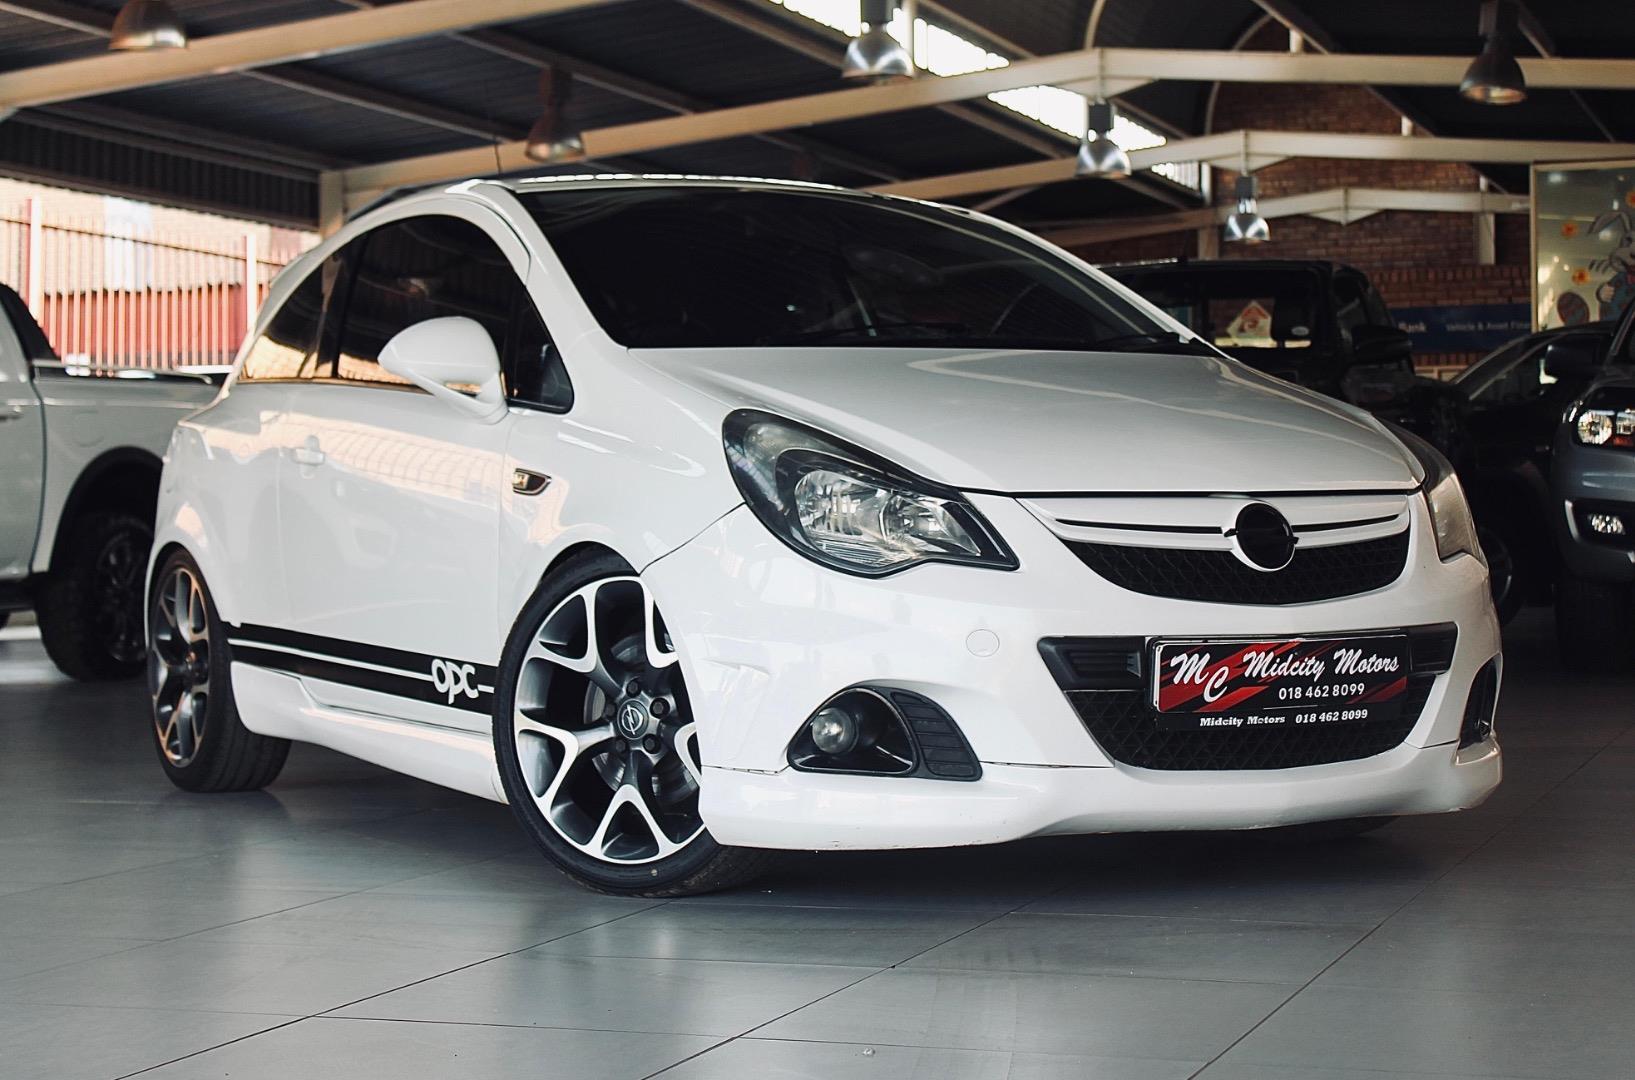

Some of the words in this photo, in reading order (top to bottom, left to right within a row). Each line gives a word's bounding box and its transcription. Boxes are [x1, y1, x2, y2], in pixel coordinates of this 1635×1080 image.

[1243, 651, 1326, 682] Midcity
[1333, 648, 1399, 674] Motors
[1279, 687, 1302, 700] 018
[1305, 685, 1329, 699] 462
[1332, 683, 1365, 697] 8099
[1200, 717, 1244, 727] Midcity
[1247, 715, 1286, 725] Motors
[1295, 714, 1316, 724] 018
[1319, 711, 1339, 722] 462
[1341, 709, 1368, 720] 8099
